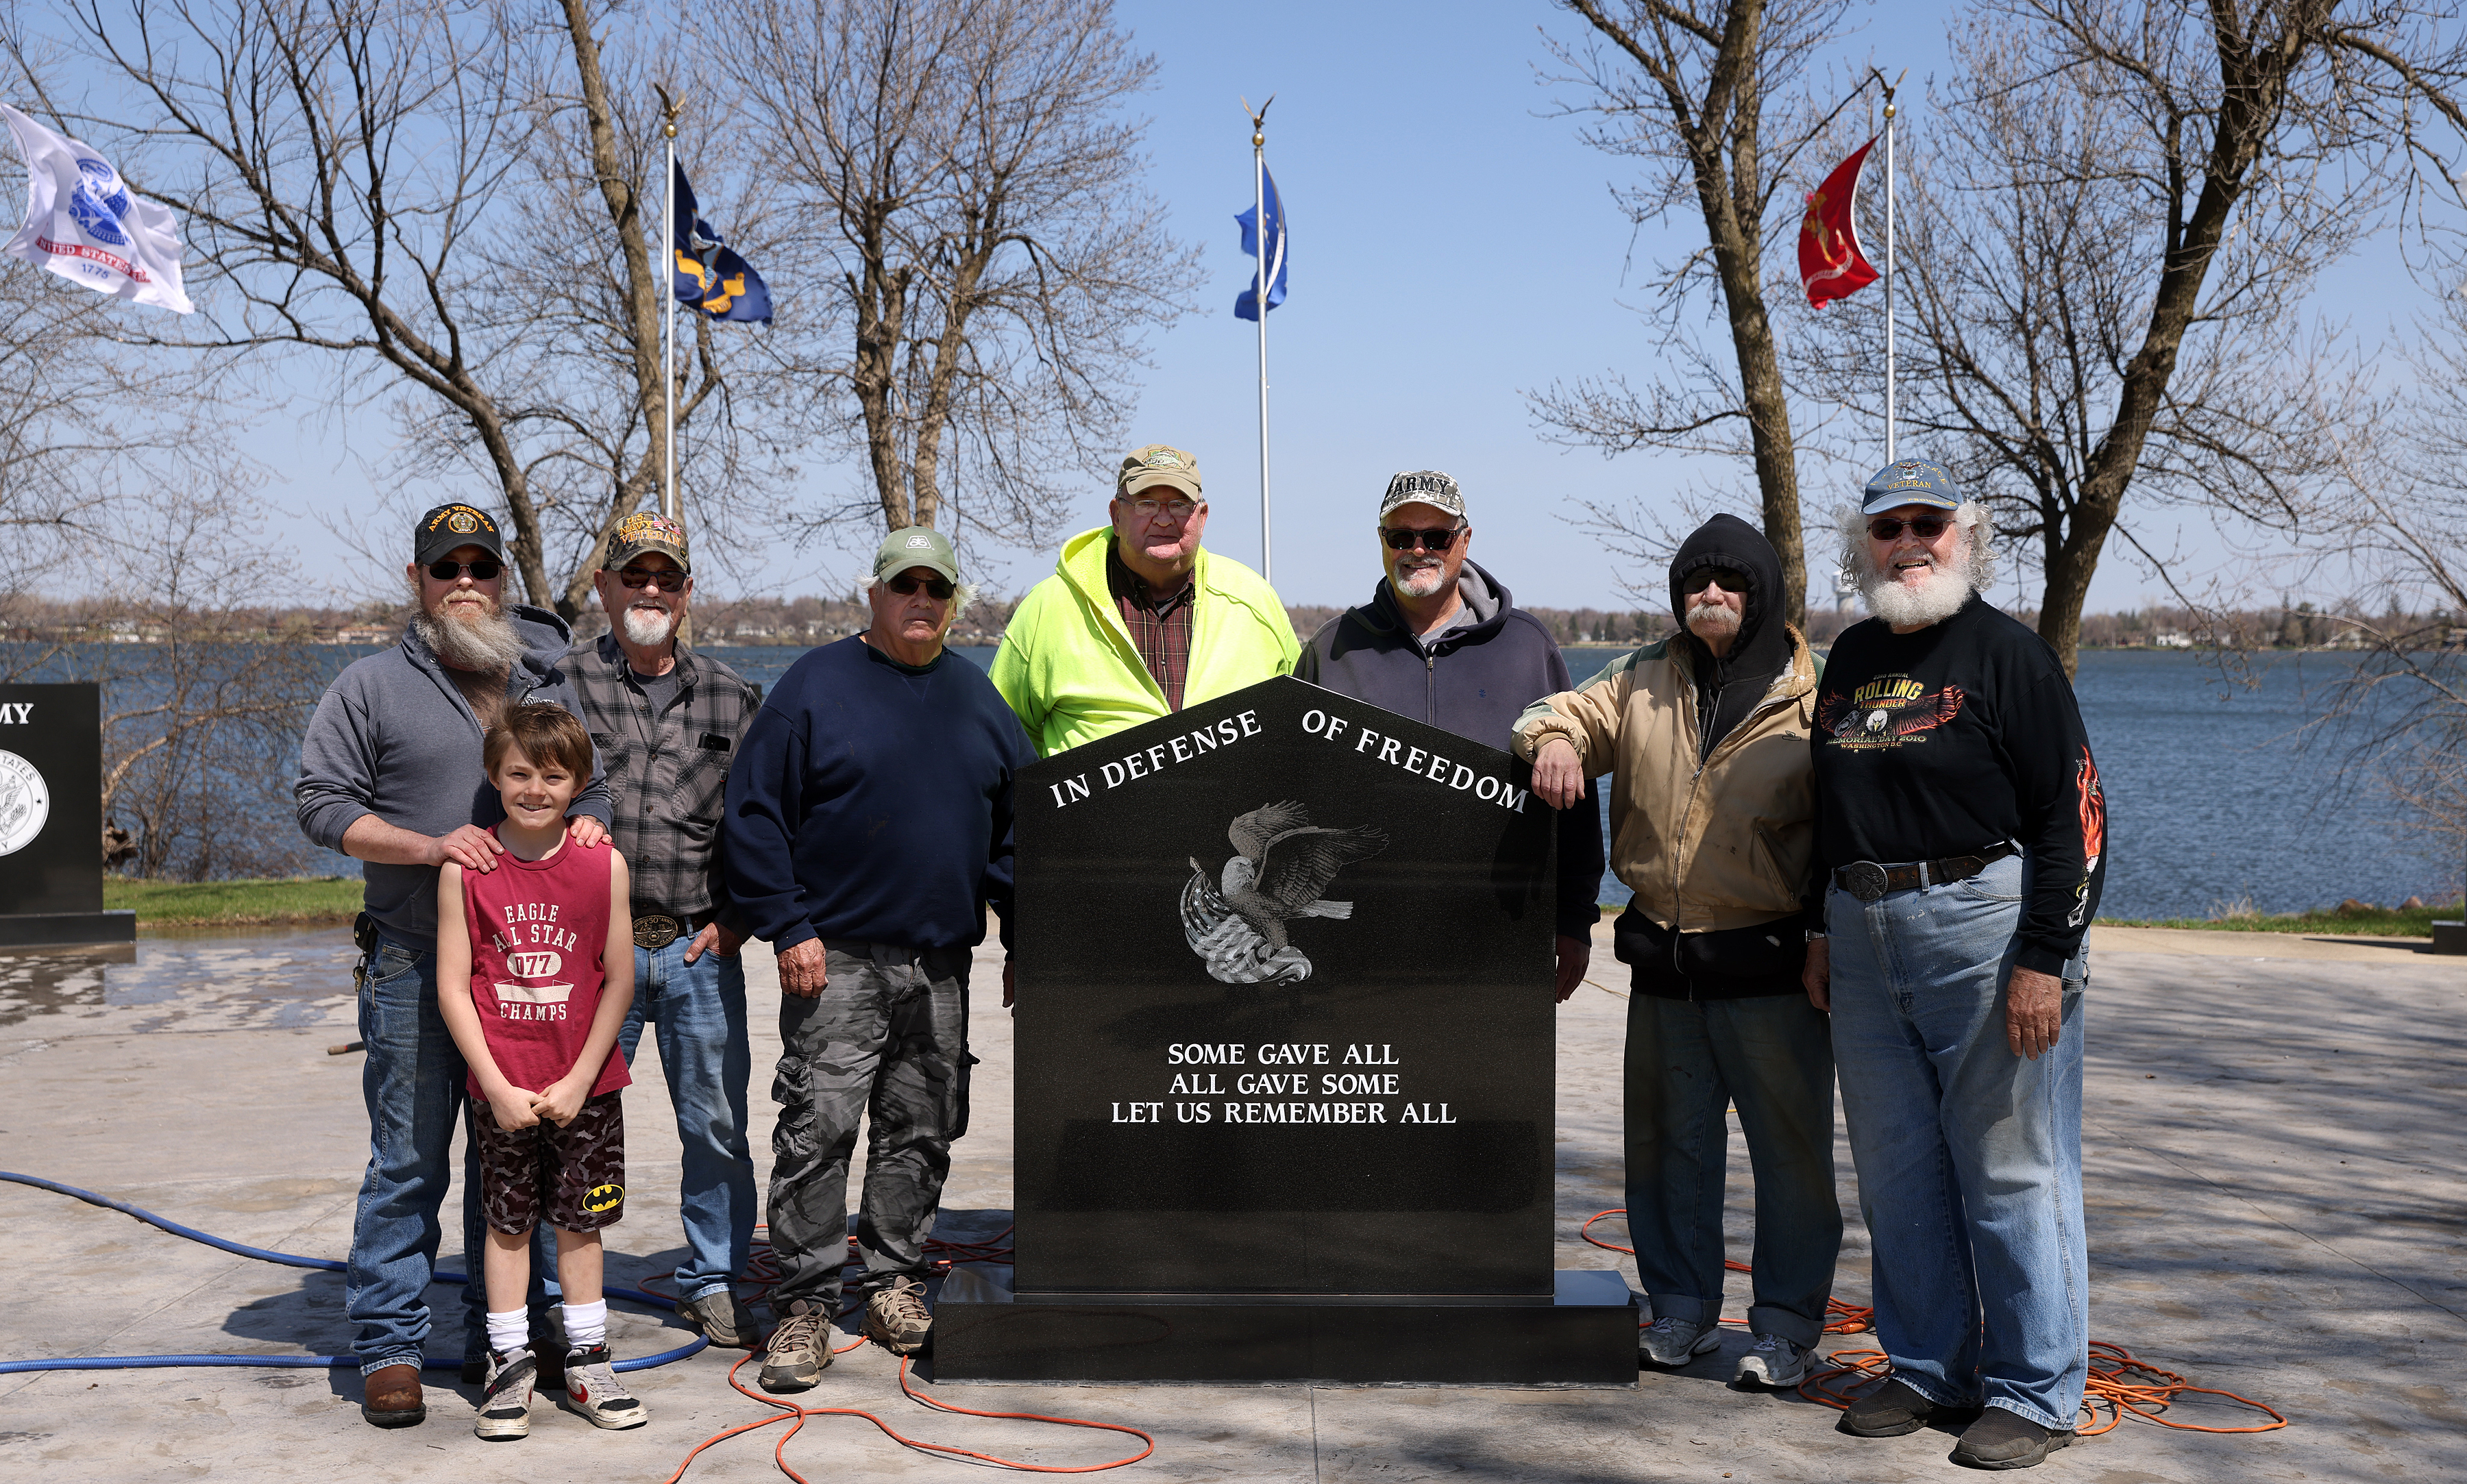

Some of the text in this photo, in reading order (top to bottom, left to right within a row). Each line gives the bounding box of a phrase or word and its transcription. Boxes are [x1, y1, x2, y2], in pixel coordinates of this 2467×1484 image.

[81, 245, 132, 275] STATES
[82, 263, 110, 280] 1775
[1391, 475, 1450, 498] ARMY
[1887, 480, 1932, 490] VETERAN
[428, 506, 495, 533] ARMY VETERAN
[619, 521, 654, 536] NAVY
[626, 512, 646, 524] U.S.
[619, 530, 681, 547] VETERAN
[1854, 679, 1924, 705] ROLLING
[1860, 698, 1907, 710] THUNDER
[1826, 737, 1878, 745] MEMORIAL
[1899, 734, 1926, 743] 2010
[0, 755, 36, 781] TATES
[1048, 709, 1530, 815] IN DEFENSE OF FREEDOM
[504, 902, 560, 924] EAGLE
[492, 924, 578, 953] ALL STAR
[500, 1002, 567, 1022] CHAMPS
[1168, 1043, 1400, 1065] SOME GAVE ALL
[1168, 1074, 1400, 1095] ALL GAVE SOME
[1111, 1102, 1457, 1124] LET US REMEMBER ALL
